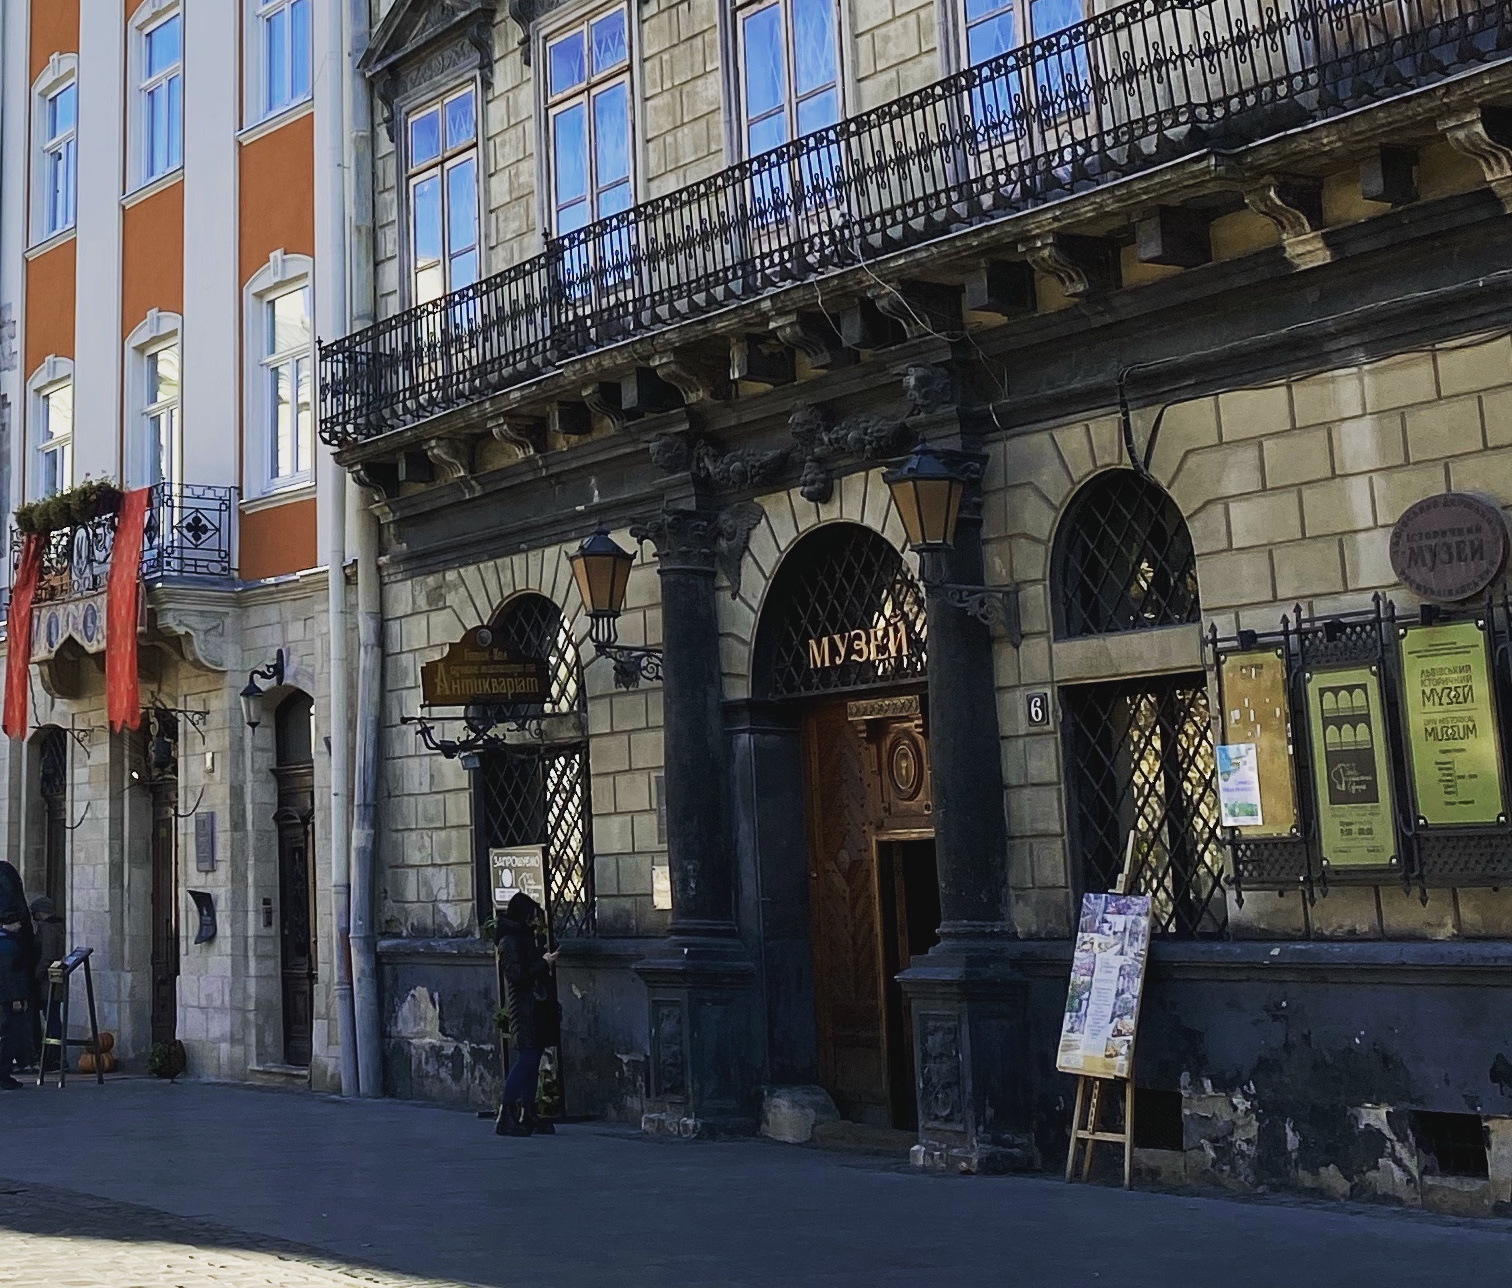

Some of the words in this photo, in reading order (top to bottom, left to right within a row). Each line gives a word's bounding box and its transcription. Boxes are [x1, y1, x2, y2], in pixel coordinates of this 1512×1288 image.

[1406, 536, 1484, 573] МУЗЕЙ
[808, 608, 908, 669] МУЗЕЙ
[434, 662, 539, 699] Антикваріат
[1421, 684, 1475, 708] МУЗЕЙ
[1031, 697, 1043, 722] 6
[1424, 723, 1478, 742] MUSEUM
